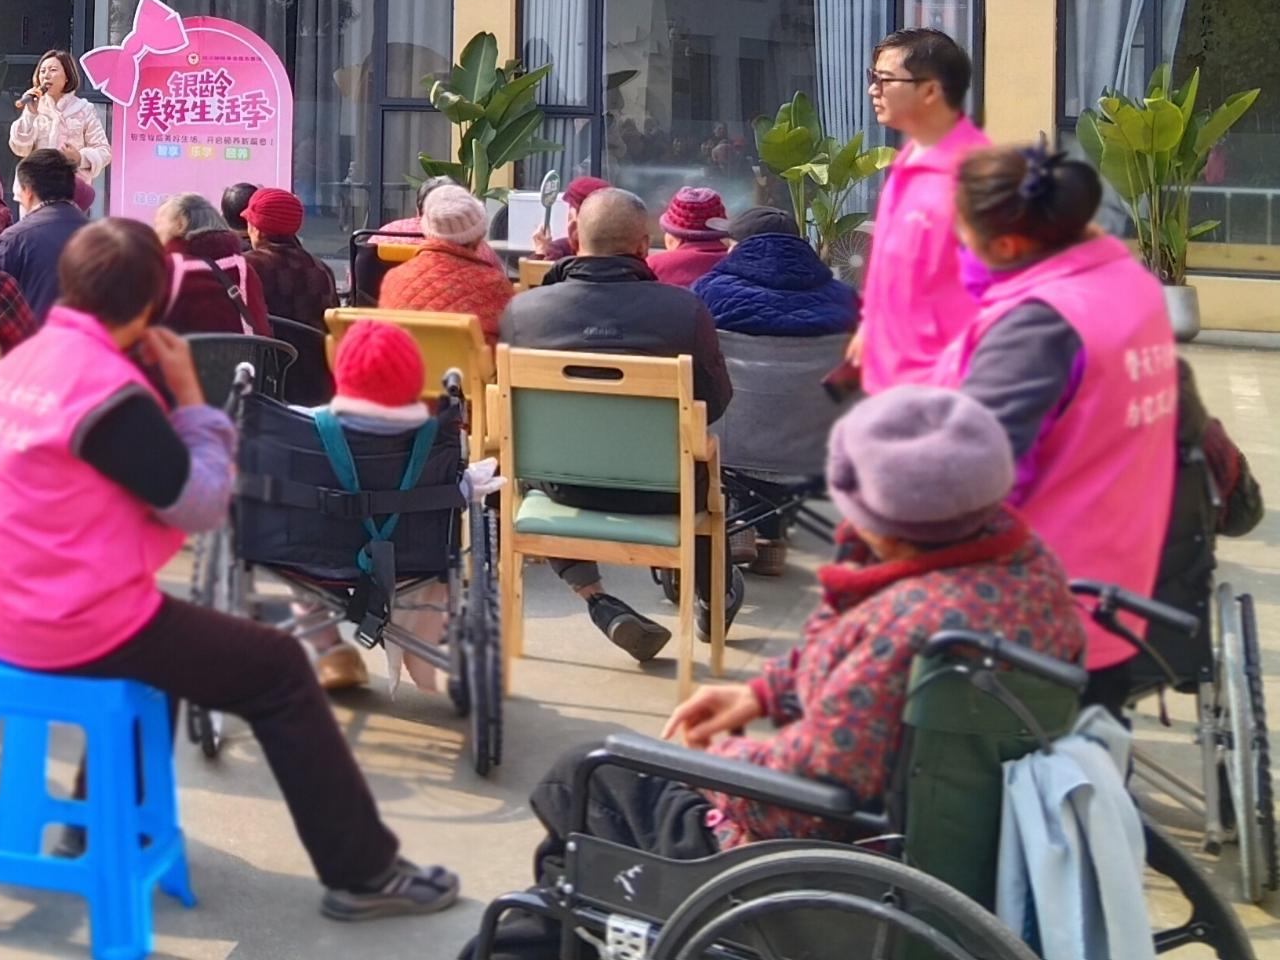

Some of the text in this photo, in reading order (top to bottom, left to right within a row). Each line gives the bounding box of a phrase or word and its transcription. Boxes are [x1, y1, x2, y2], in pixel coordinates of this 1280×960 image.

[168, 68, 234, 98] 银龄
[138, 89, 274, 133] 美好生活季
